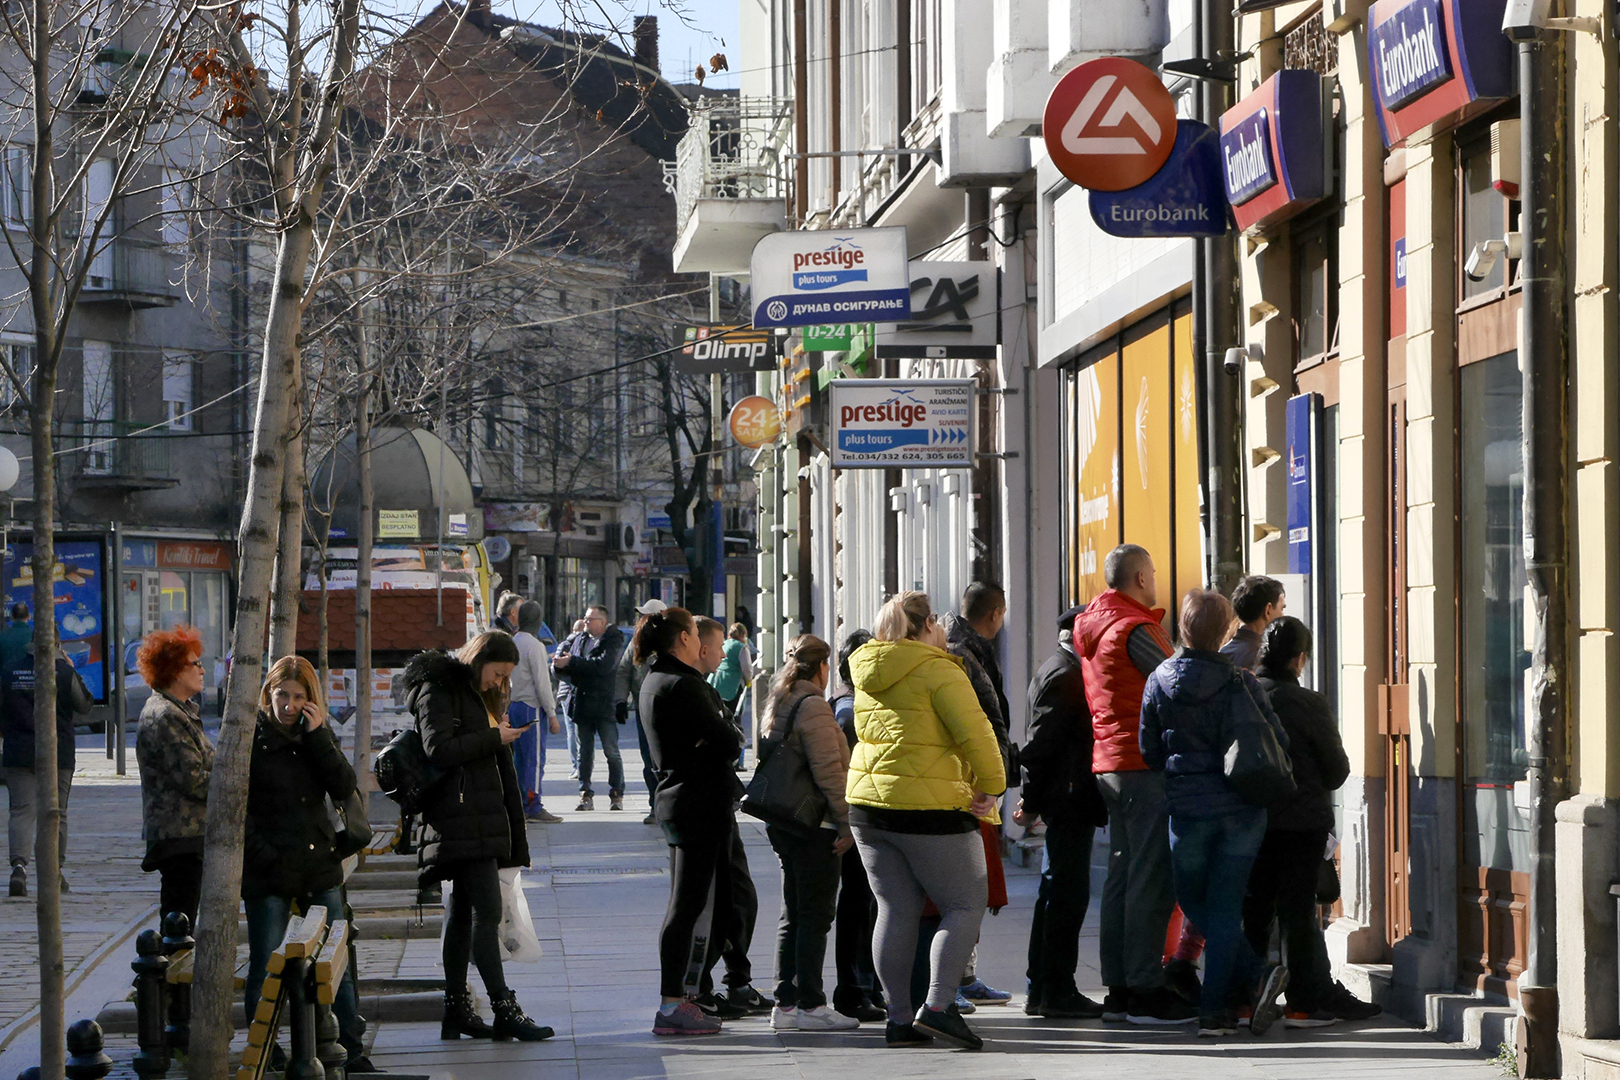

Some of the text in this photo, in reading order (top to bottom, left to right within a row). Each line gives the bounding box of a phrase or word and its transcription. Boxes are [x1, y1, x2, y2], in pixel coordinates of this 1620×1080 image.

[1379, 7, 1440, 97] Eurobank
[1225, 122, 1267, 194] Eurobank
[1111, 203, 1210, 222] Eurobank
[793, 246, 864, 271] prestige
[798, 275, 838, 286] plus tours
[793, 299, 904, 315] ДУНАВ ОСИГУРАЊЕ
[808, 325, 846, 339] 0-24
[694, 340, 767, 367] Olimp
[934, 388, 968, 396] TURISTIČKI
[737, 407, 767, 428] 24
[841, 399, 927, 428] prestige
[736, 427, 766, 438] SATA
[845, 434, 893, 446] plus tours
[841, 453, 899, 461] Tel.034/332
[902, 453, 923, 461] 624,
[194, 547, 220, 565] Travel
